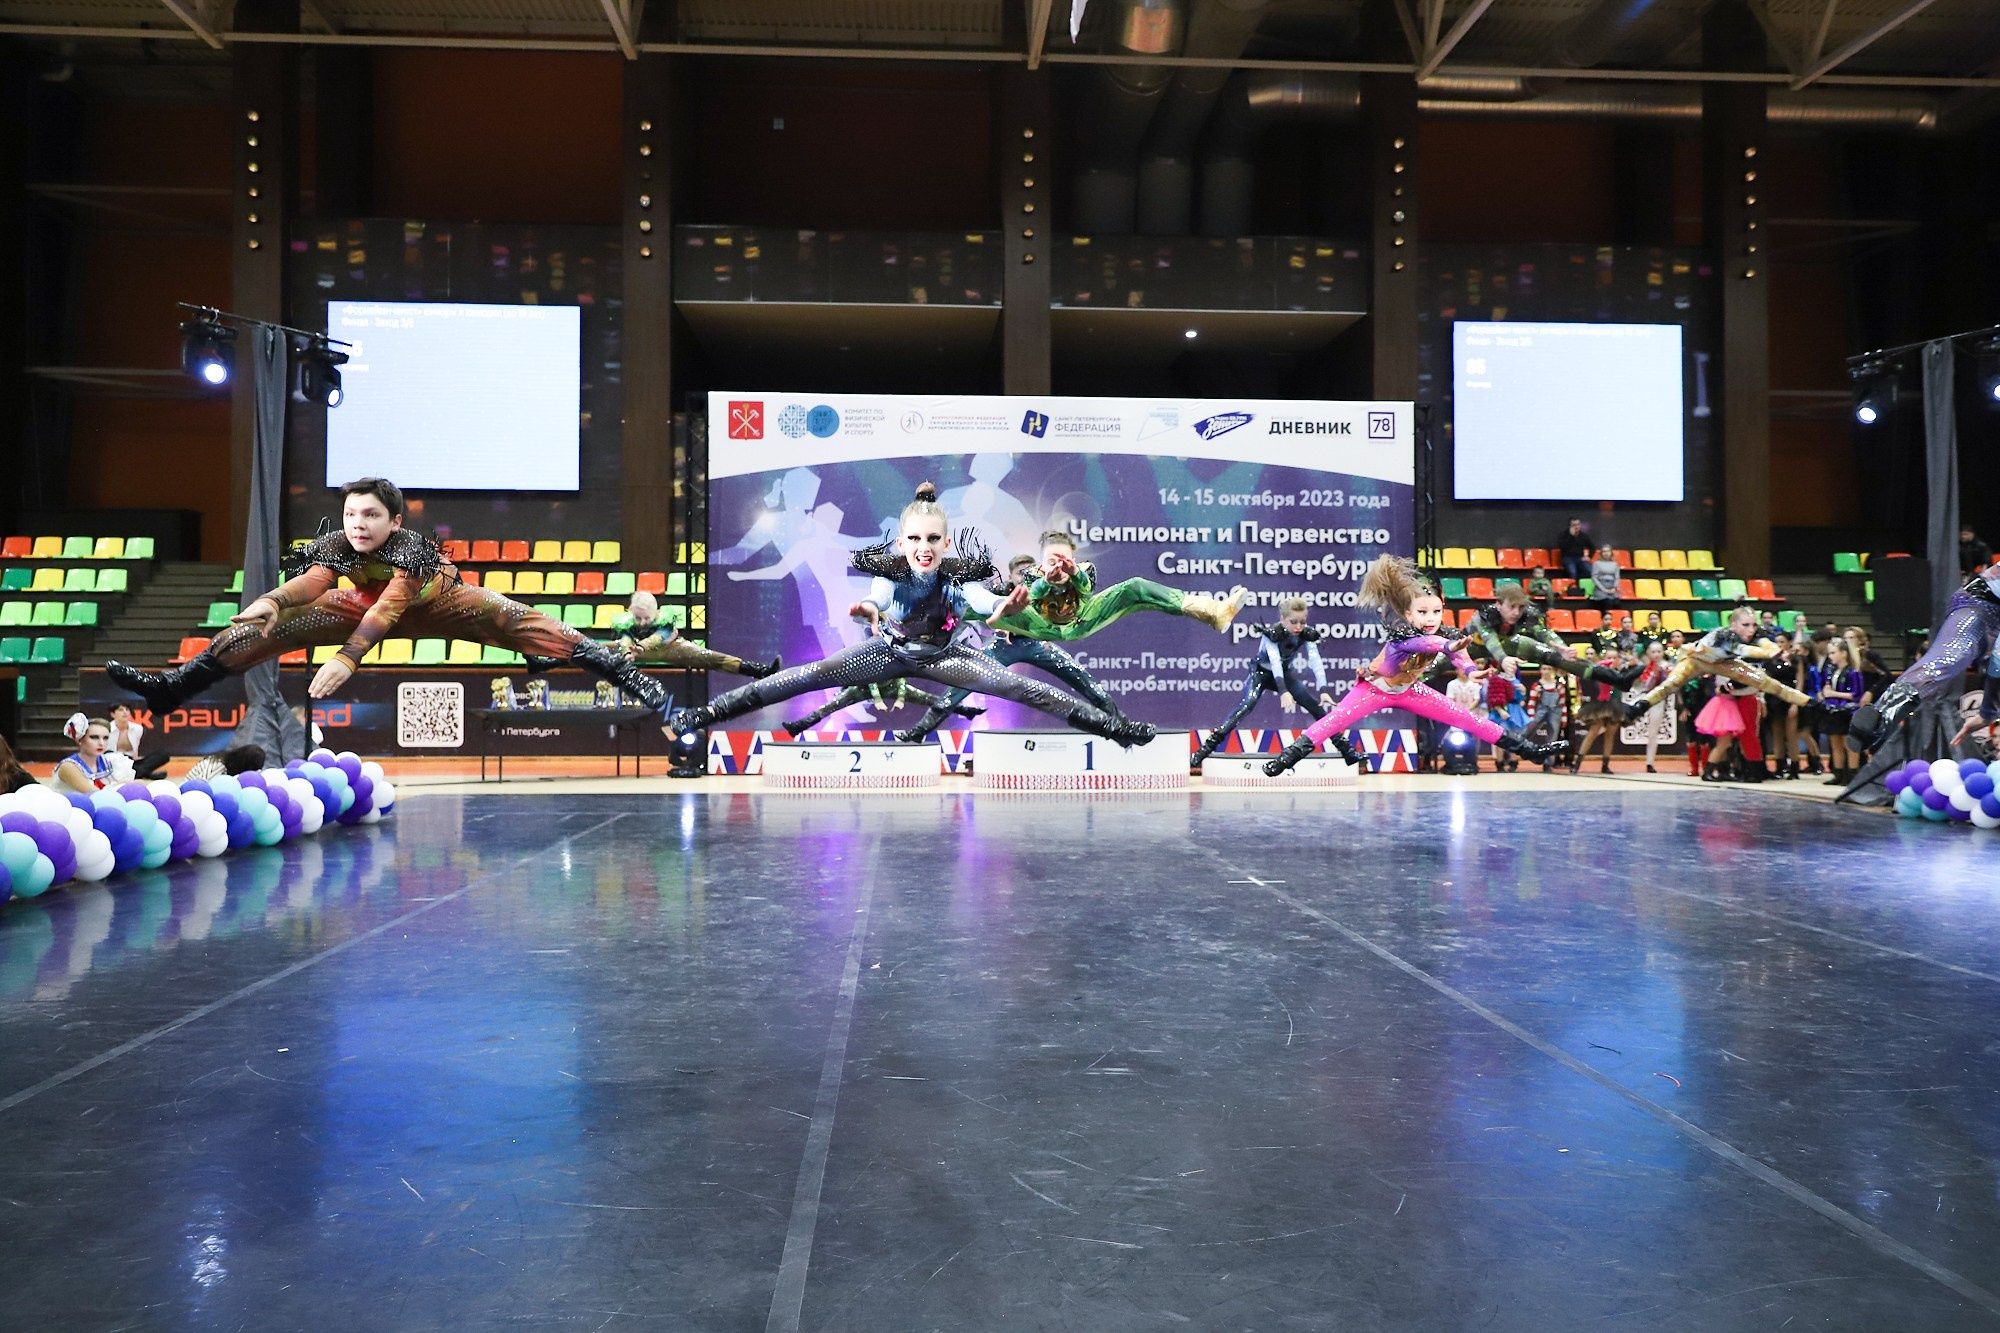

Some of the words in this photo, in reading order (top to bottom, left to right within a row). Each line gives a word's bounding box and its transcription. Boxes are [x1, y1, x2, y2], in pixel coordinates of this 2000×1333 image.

[1054, 423, 1121, 432] ФЕДЕРАЦИЯ
[1268, 421, 1352, 435] ДНЕВНИК
[1373, 418, 1391, 433] 78
[1158, 488, 1180, 506] 14
[1194, 488, 1214, 506] 15
[1218, 489, 1295, 510] октября
[1299, 489, 1345, 507] 2023
[1348, 495, 1391, 509] года
[1069, 519, 1212, 543] Чемпионат
[1217, 527, 1233, 543] и
[1239, 520, 1391, 549] Первенство
[1157, 552, 1375, 581] Санкт-Петербур
[848, 750, 862, 773] 2
[1082, 740, 1097, 771] 1
